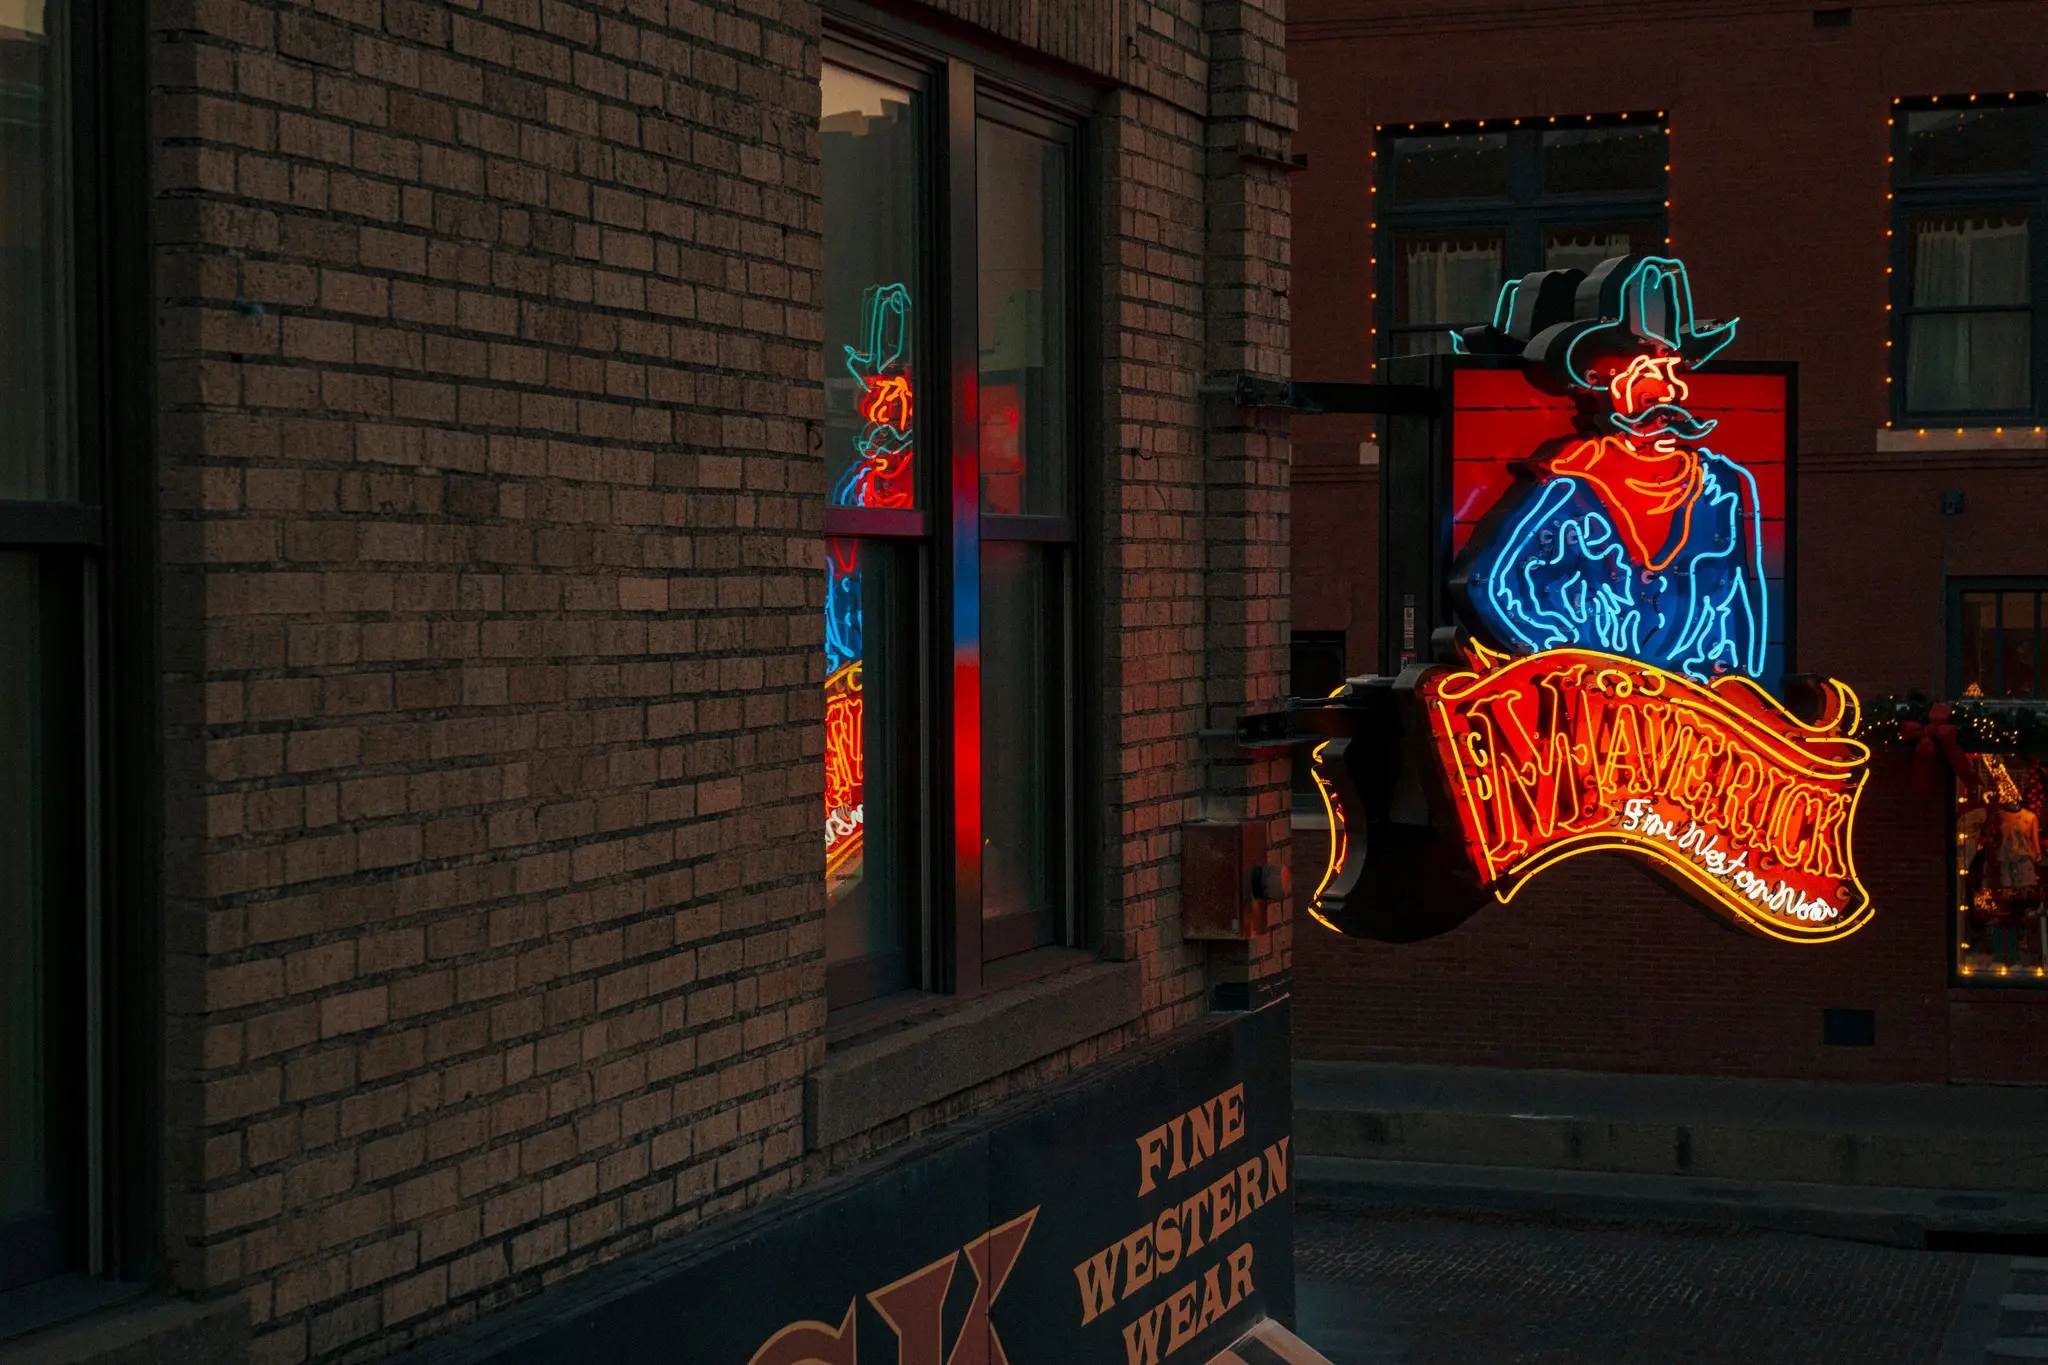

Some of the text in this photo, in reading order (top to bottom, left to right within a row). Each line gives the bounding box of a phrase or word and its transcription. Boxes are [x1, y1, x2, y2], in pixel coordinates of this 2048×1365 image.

[1466, 664, 1852, 878] MAVERICK
[1622, 797, 1679, 842] Fine
[1136, 1083, 1245, 1198] FINE
[1074, 1136, 1290, 1327] WESTERN
[1122, 1243, 1255, 1365] WEAR
